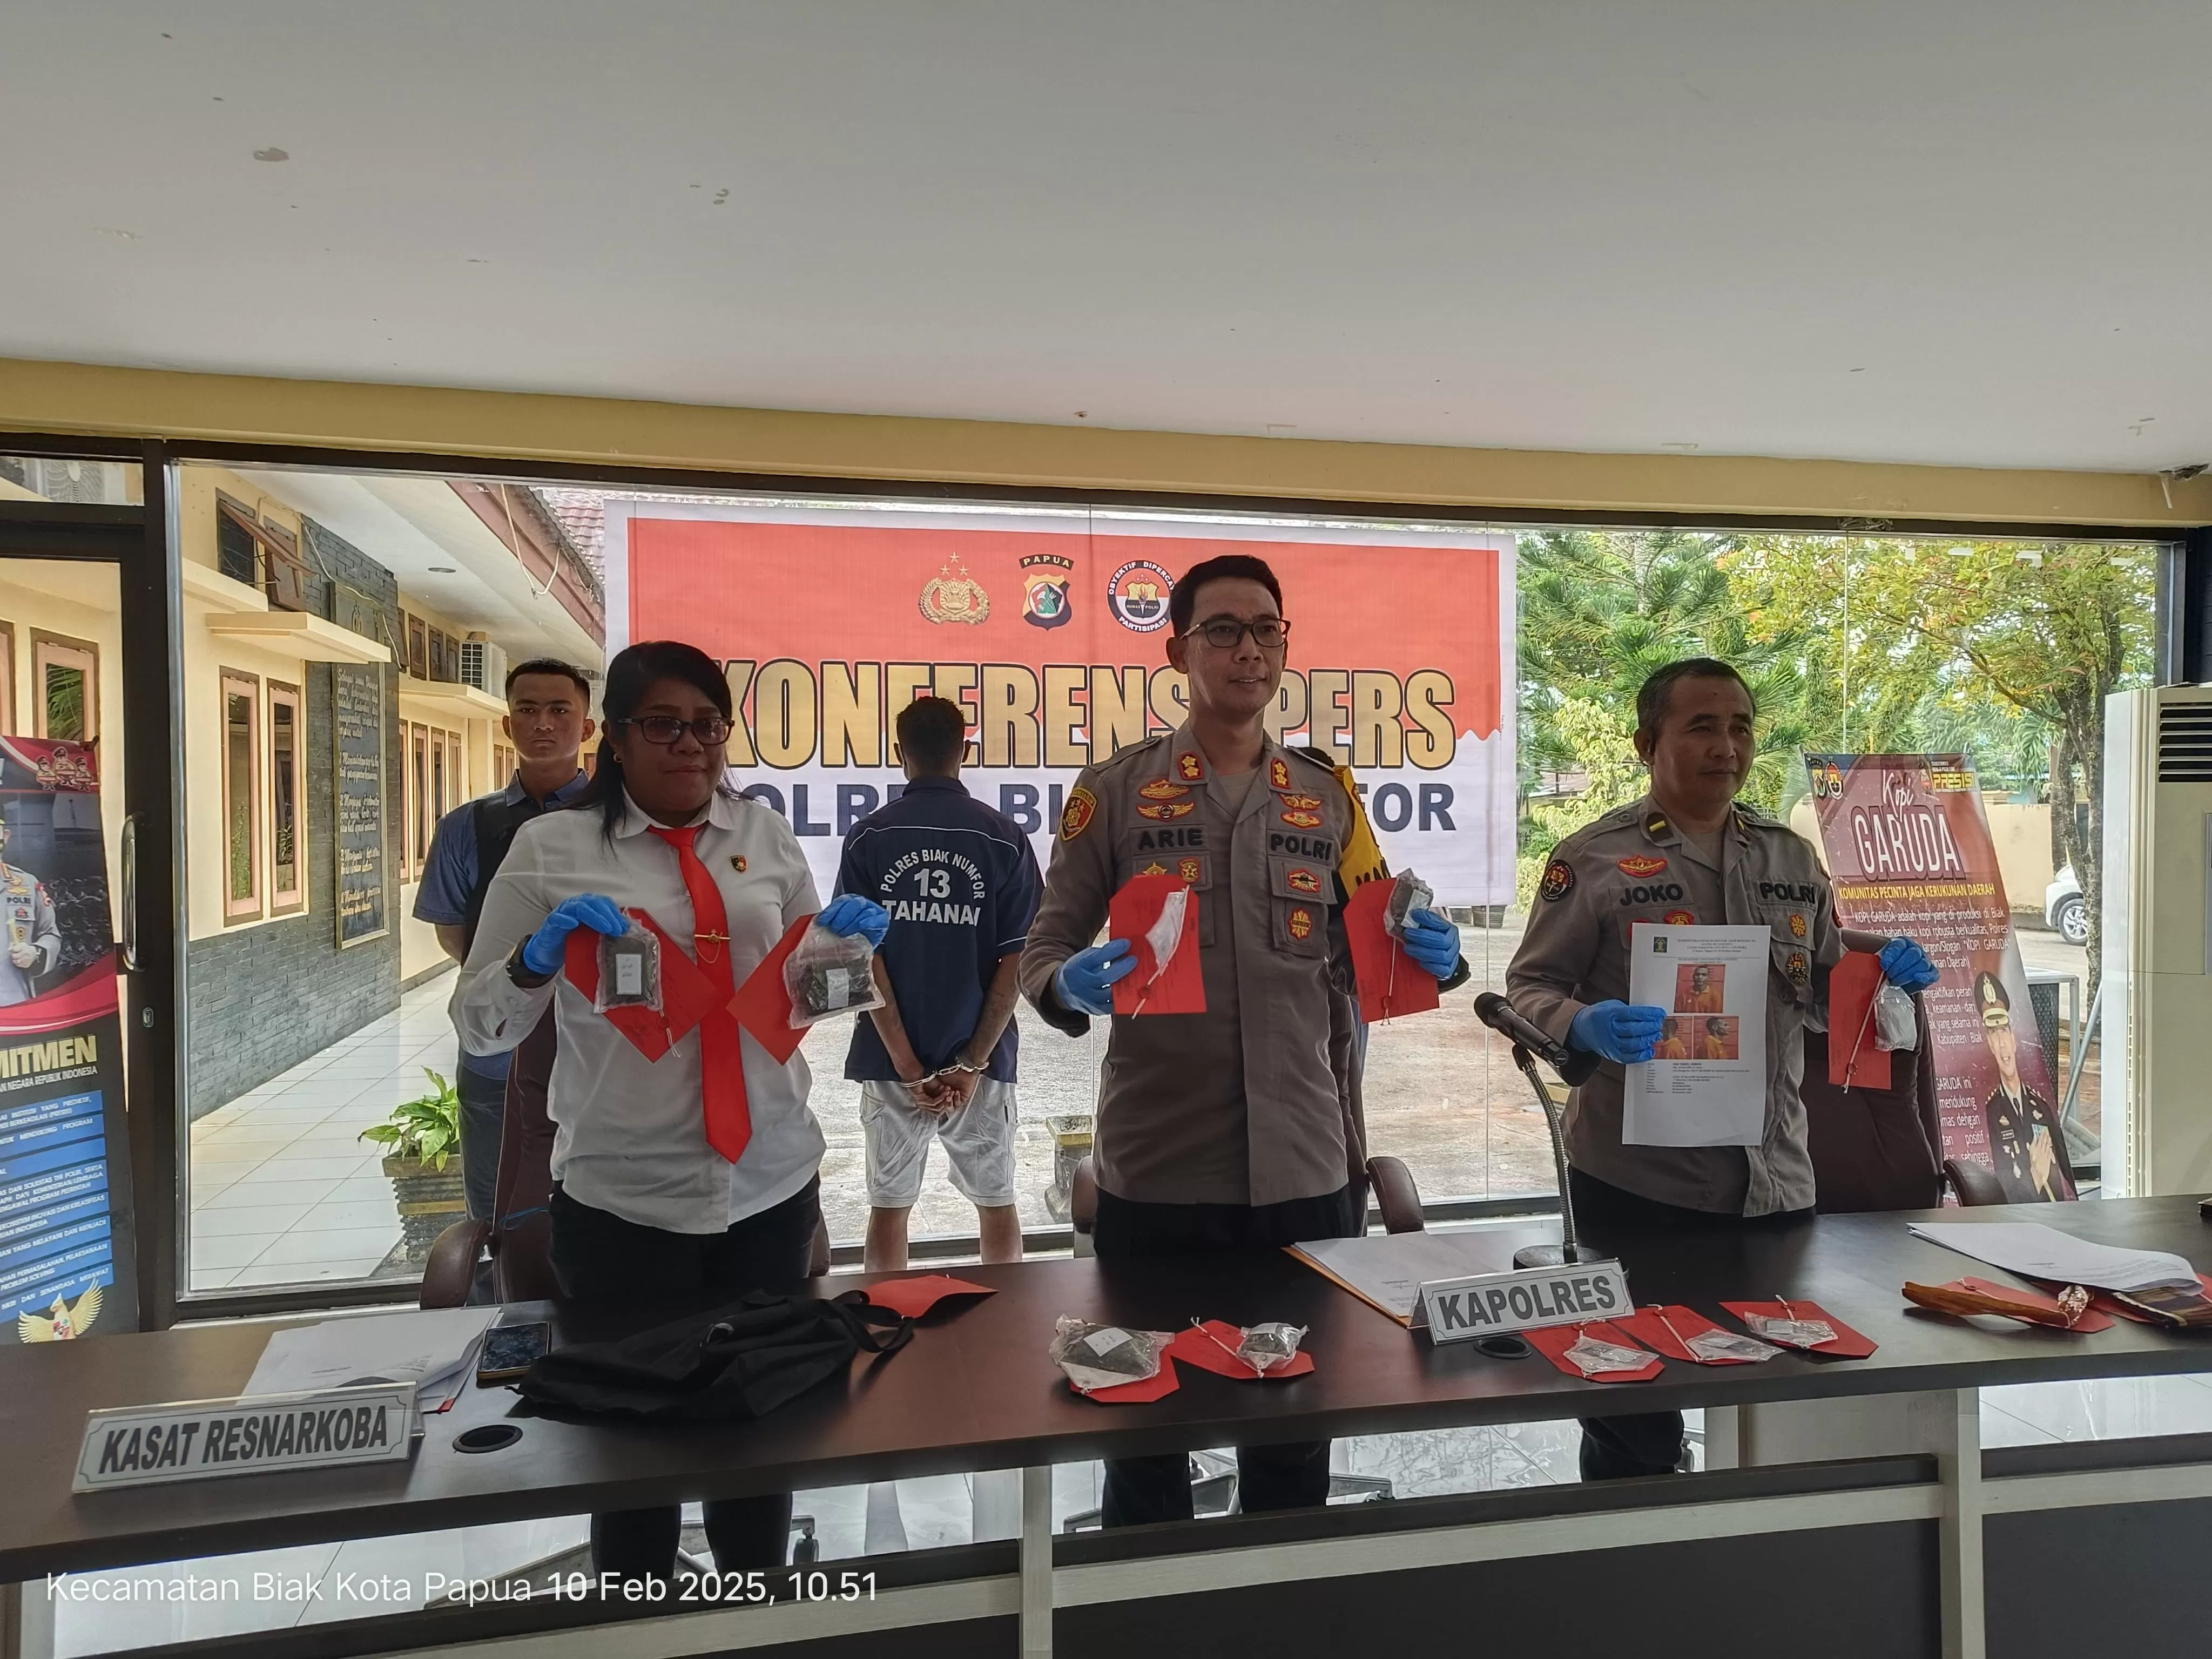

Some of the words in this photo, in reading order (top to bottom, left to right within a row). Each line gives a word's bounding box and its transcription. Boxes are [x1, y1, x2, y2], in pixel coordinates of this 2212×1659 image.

[1023, 556, 1070, 568] PAPUA
[1108, 561, 1136, 595] OBYEKTIF
[1143, 561, 1175, 591] DIPERCAY
[1118, 616, 1168, 632] PARTISIPASI
[714, 658, 1190, 771] KONFERENS
[1263, 669, 1456, 771] PERS
[1883, 769, 1915, 822] Kopi
[999, 783, 1063, 835] BI
[1137, 828, 1203, 851] ARIE
[1271, 833, 1332, 861] POLRI
[1854, 813, 1960, 874] GARUDA
[880, 851, 920, 893] POLRES
[921, 849, 950, 863] BIAK
[952, 853, 986, 900] NUMFOR
[914, 868, 951, 899] 13
[1620, 883, 1684, 906] JOKO
[1759, 882, 1816, 905] POLRI
[1838, 886, 1879, 900] KOMUNITAS
[1879, 886, 1908, 899] PECINTA
[1907, 885, 1925, 900] JAGA
[1925, 884, 1967, 898] KERUKUNAN
[1967, 883, 1996, 896] DAERAH
[1854, 911, 1870, 923] KOPI
[1871, 911, 1896, 923] GARUDA
[1897, 910, 1917, 921] adalah
[1918, 911, 1932, 923] kopi
[1933, 911, 1947, 923] yang
[1948, 909, 1955, 920] di
[1956, 908, 1982, 923] produksi
[1983, 908, 1990, 919] di
[1991, 908, 2005, 918] Biak
[1902, 926, 1918, 937] baku
[1918, 925, 1932, 940] kopi
[1932, 924, 1955, 938] robusta
[1954, 923, 1989, 936] berkualitas,
[1988, 922, 2009, 934] Polres
[1946, 955, 1971, 969] Daerah)
[1956, 987, 1973, 1001] peran
[1932, 1003, 1961, 1015] keamanan
[1965, 1001, 1977, 1013] dan
[1936, 1020, 1952, 1032] yang
[1951, 1017, 1971, 1028] selama
[1972, 1016, 1980, 1027] ini
[1937, 1033, 1967, 1047] Kabupaten
[1970, 1032, 1984, 1043] Biak
[8, 1078, 34, 1091] NEGARA
[35, 1071, 62, 1085] REPUBLIK
[62, 1065, 98, 1080] INDONESIA
[1962, 1076, 1972, 1089] ini
[41, 1103, 59, 1111] YANG
[1939, 1094, 1977, 1111] mendukung
[62, 1118, 93, 1130] PROGRAM
[1957, 1112, 1981, 1129] dengan
[1965, 1130, 1985, 1148] positif
[8, 1185, 23, 1195] DAN
[0, 1199, 29, 1213] ENGAWAL
[29, 1190, 60, 1204] PROGRAM
[56, 1205, 70, 1214] DAN
[15, 1219, 49, 1234] INDONESIA
[12, 1242, 31, 1253] YANG
[32, 1232, 64, 1247] MELAYANI
[64, 1227, 78, 1237] DAN
[78, 1219, 107, 1232] MENJADI
[65, 1243, 108, 1262] PELAKSANAAN
[1, 1276, 28, 1291] PROBLEM
[28, 1267, 56, 1283] SOLVING
[21, 1293, 36, 1303] DAN
[1438, 1274, 1616, 1331] KAPOLRES
[98, 1420, 201, 1475] KASAT
[201, 1405, 388, 1465] RESNARKOBA
